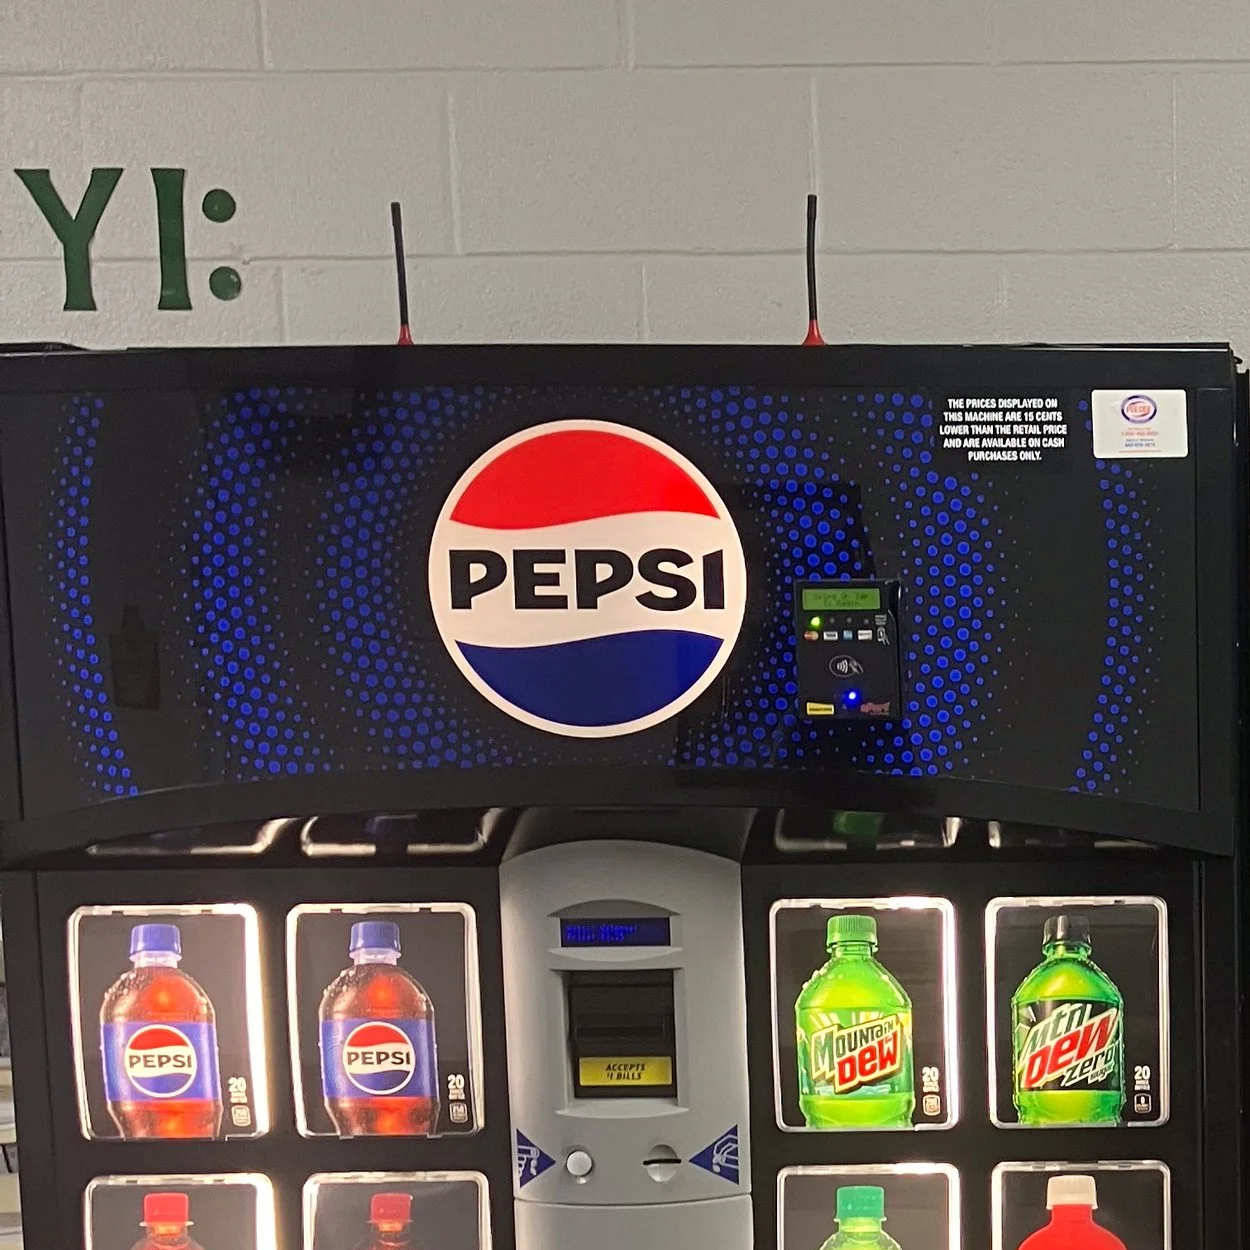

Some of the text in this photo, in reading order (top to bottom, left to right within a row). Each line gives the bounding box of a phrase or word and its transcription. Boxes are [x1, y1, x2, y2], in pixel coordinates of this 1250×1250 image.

[948, 398, 1058, 408] THE PRICES DISPLAYED ON
[944, 412, 1062, 422] THIS MACHINE ARE 15 CENTS
[940, 425, 1067, 435] LOWER THAN THE RETAIL PRICE
[944, 438, 1064, 448] AND ARE AVAILABLE ON CASH
[968, 451, 1042, 461] PURCHASES ONLY.
[447, 547, 726, 611] PEPSI
[128, 1053, 193, 1069] PEPSI
[346, 1050, 411, 1066] PEPSI
[605, 1063, 646, 1072] ACCEPTS
[922, 1066, 939, 1081] 20
[1134, 1065, 1150, 1080] 20
[447, 1074, 465, 1089] 20
[616, 1072, 642, 1080] BILLS
[228, 1077, 247, 1092] 20
